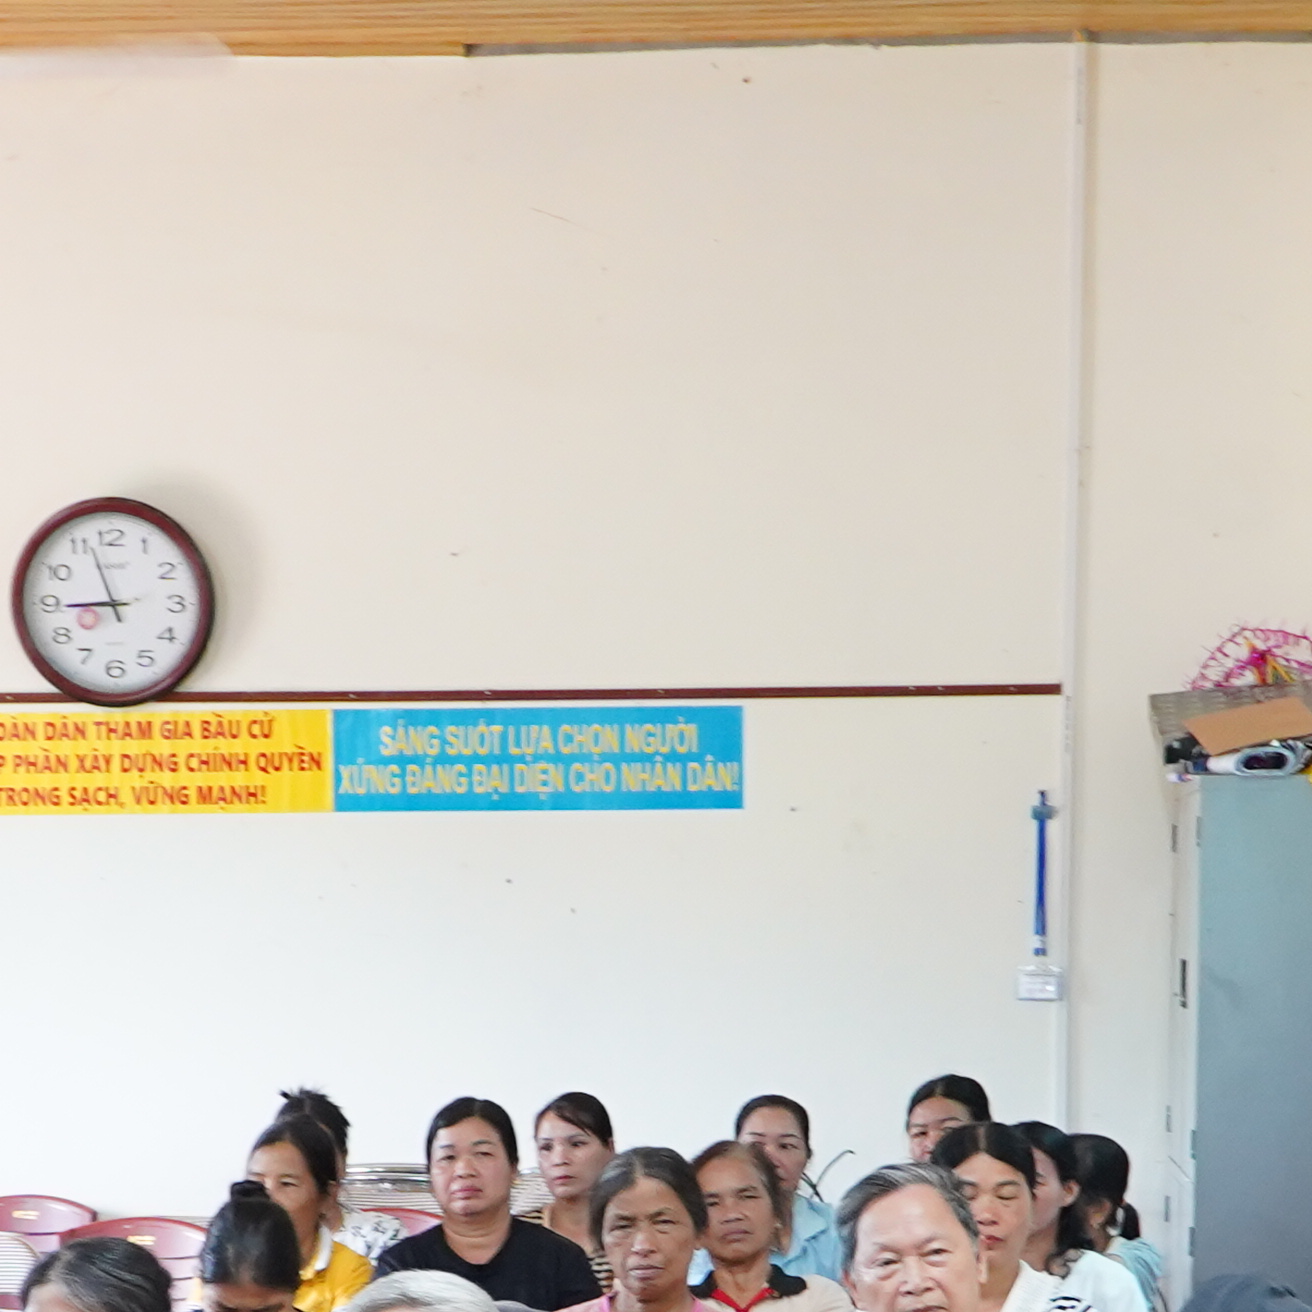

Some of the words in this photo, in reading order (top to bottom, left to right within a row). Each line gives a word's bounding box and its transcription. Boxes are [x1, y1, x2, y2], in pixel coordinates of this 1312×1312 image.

[70, 537, 88, 554] 11
[97, 528, 126, 547] 12
[141, 537, 149, 554] 1
[46, 564, 72, 581] 10
[157, 561, 178, 580] 2
[40, 594, 60, 613] 9
[166, 594, 187, 614] 3
[51, 626, 72, 645] 8
[156, 627, 178, 643] 4
[77, 648, 93, 665] 7
[136, 650, 155, 667] 5
[105, 660, 127, 678] 6
[43, 715, 88, 741] DÂN
[93, 720, 154, 741] THAM
[160, 720, 195, 740] GIA
[200, 711, 241, 740] BẦU
[247, 711, 276, 739] CỬ
[379, 718, 441, 756] SÁNG
[445, 718, 504, 755] SUỐT
[507, 724, 556, 762] LỰA
[558, 723, 620, 761] CHỌN
[624, 716, 699, 753] NGƯỜI
[13, 746, 70, 774] PHẦN
[75, 747, 114, 774] XÂY
[120, 750, 179, 778] DỰNG
[185, 746, 250, 773] CHÍNH
[256, 743, 323, 774] QUYỀN
[338, 757, 402, 794] XỨNG
[406, 757, 469, 794] ĐÁNG
[472, 763, 510, 800] ĐẠI
[513, 761, 565, 800] DIỆN
[569, 762, 617, 792] CHO
[621, 755, 683, 792] NHÂN
[687, 754, 739, 791] DÂN!
[67, 786, 127, 811] SẠCH,
[131, 780, 190, 806] VỮNG
[196, 785, 267, 811] MẠNH!
